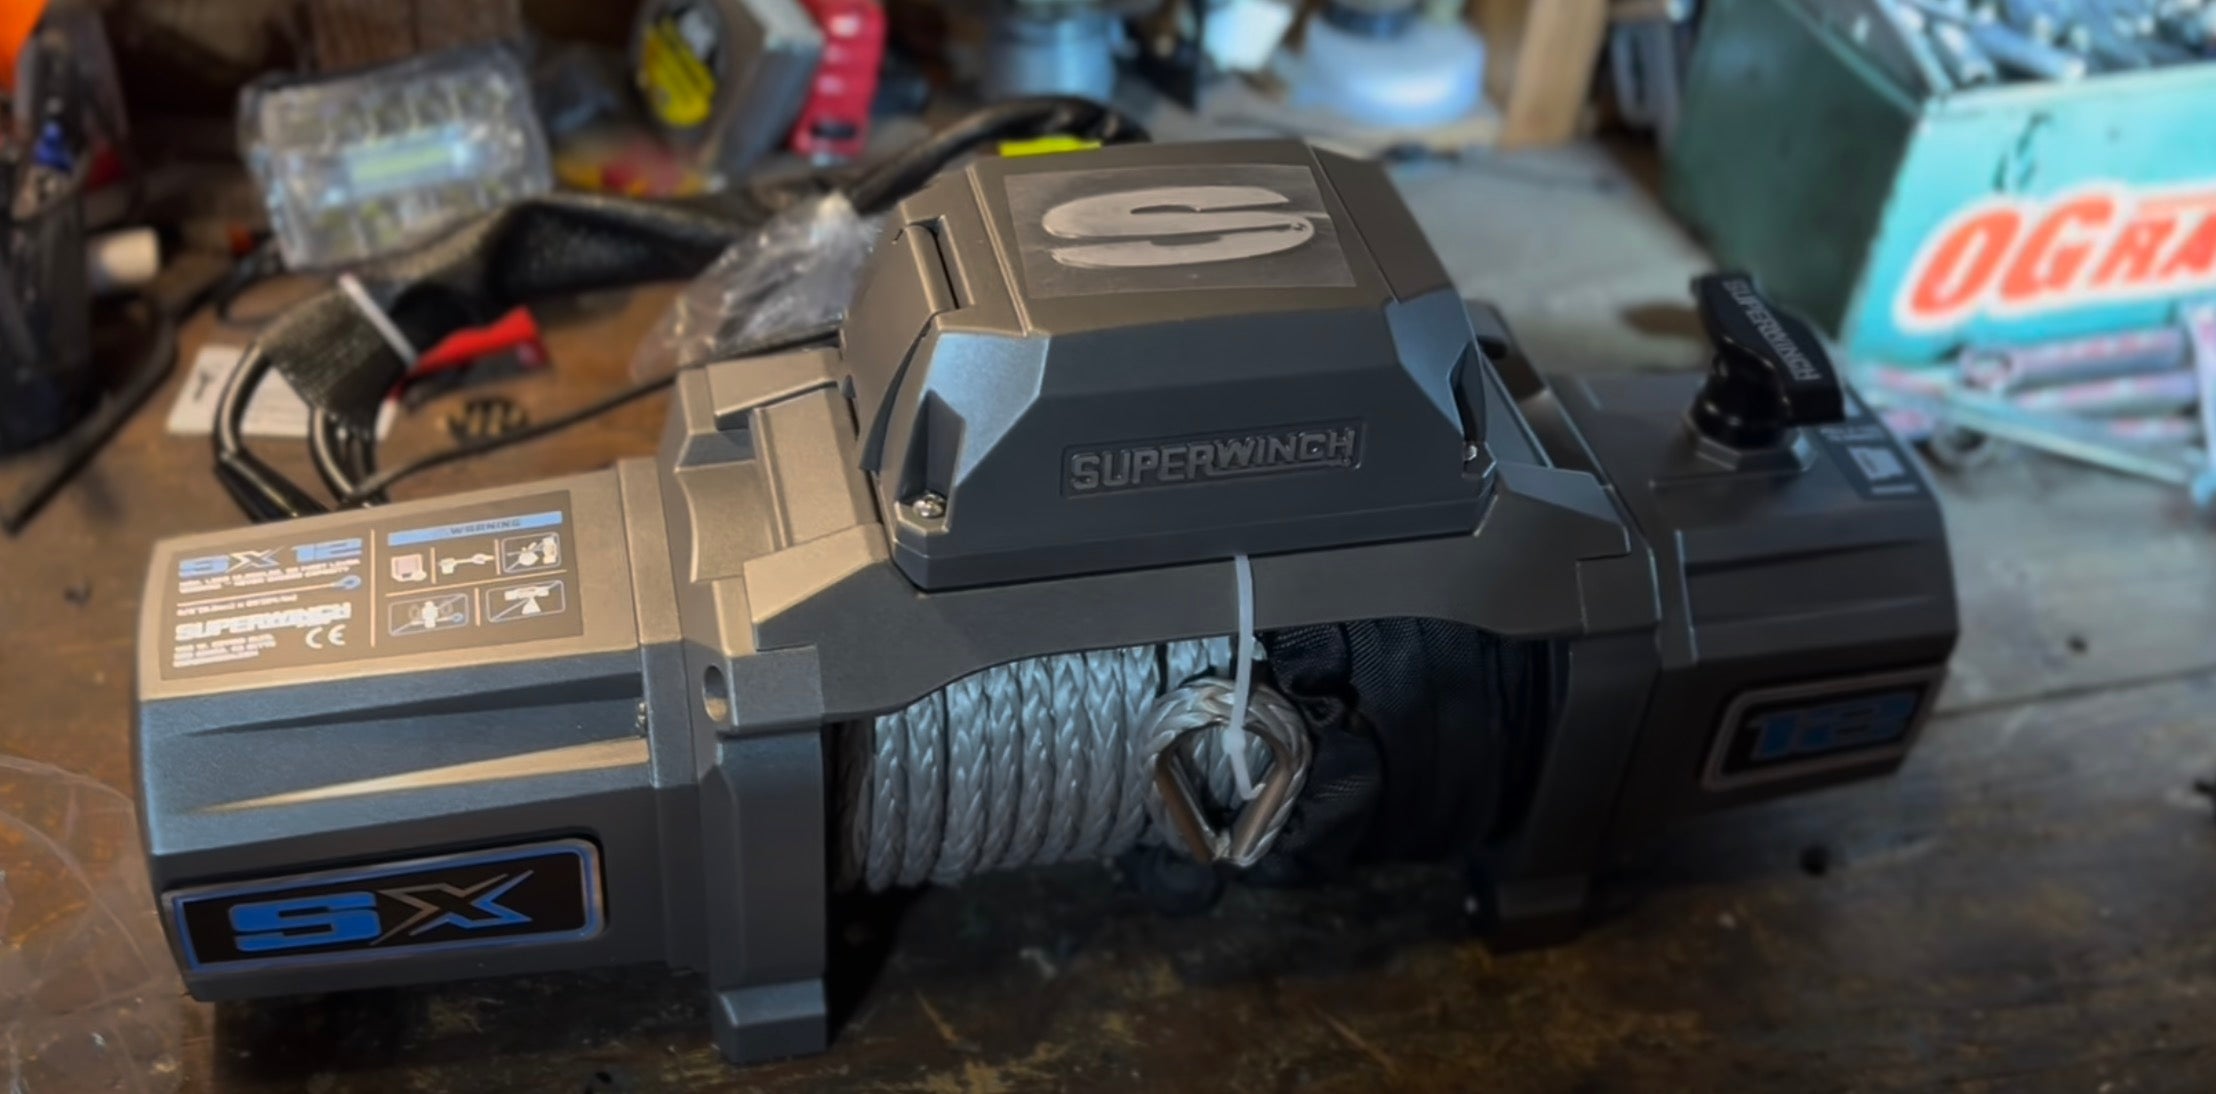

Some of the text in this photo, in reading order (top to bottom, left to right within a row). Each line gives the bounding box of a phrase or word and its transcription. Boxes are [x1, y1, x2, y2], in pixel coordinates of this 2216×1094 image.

[1042, 186, 1314, 269] S
[1722, 278, 1822, 381] SUPERWINCH
[1070, 428, 1355, 491] SUPERWINCH
[229, 869, 534, 953] SX
